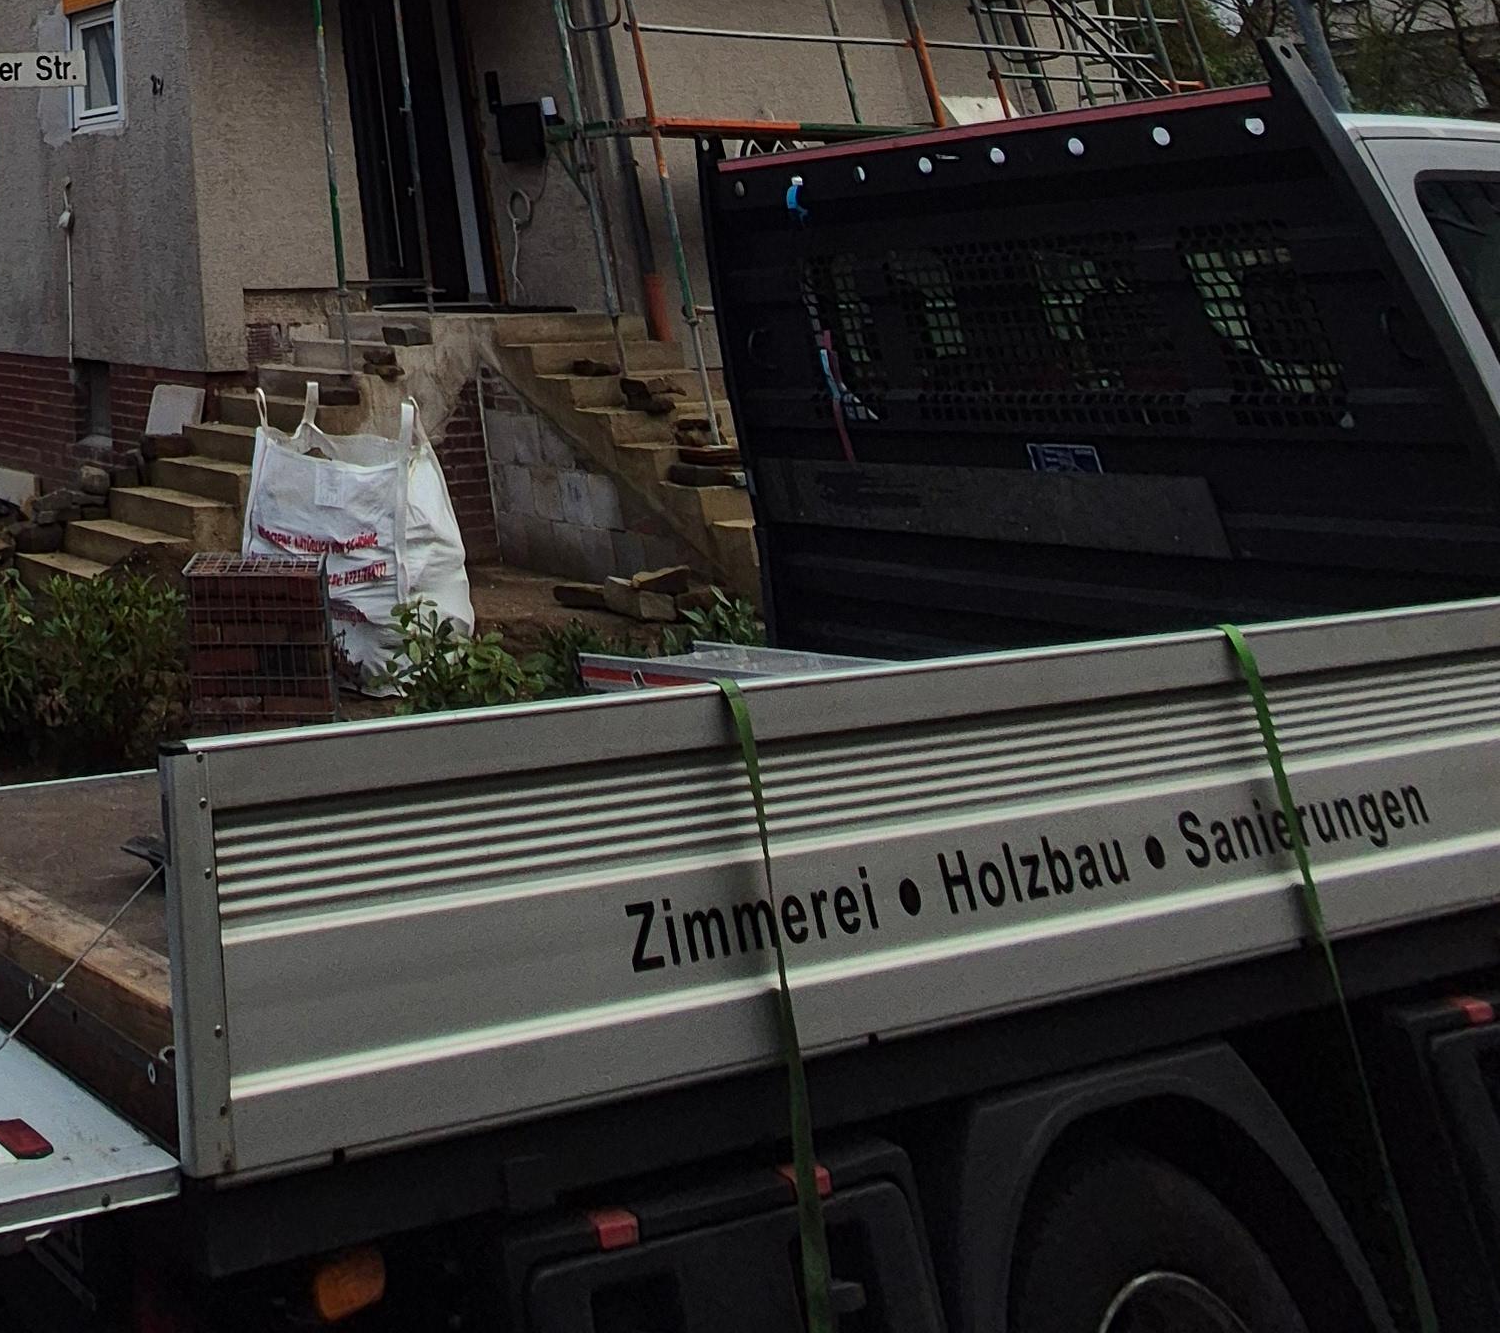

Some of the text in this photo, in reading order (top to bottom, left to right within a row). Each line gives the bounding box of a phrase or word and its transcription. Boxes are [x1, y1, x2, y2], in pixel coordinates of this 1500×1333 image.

[36, 55, 77, 81] Str.
[625, 784, 1431, 973] Zimmerei Holzbau Sanierungen
